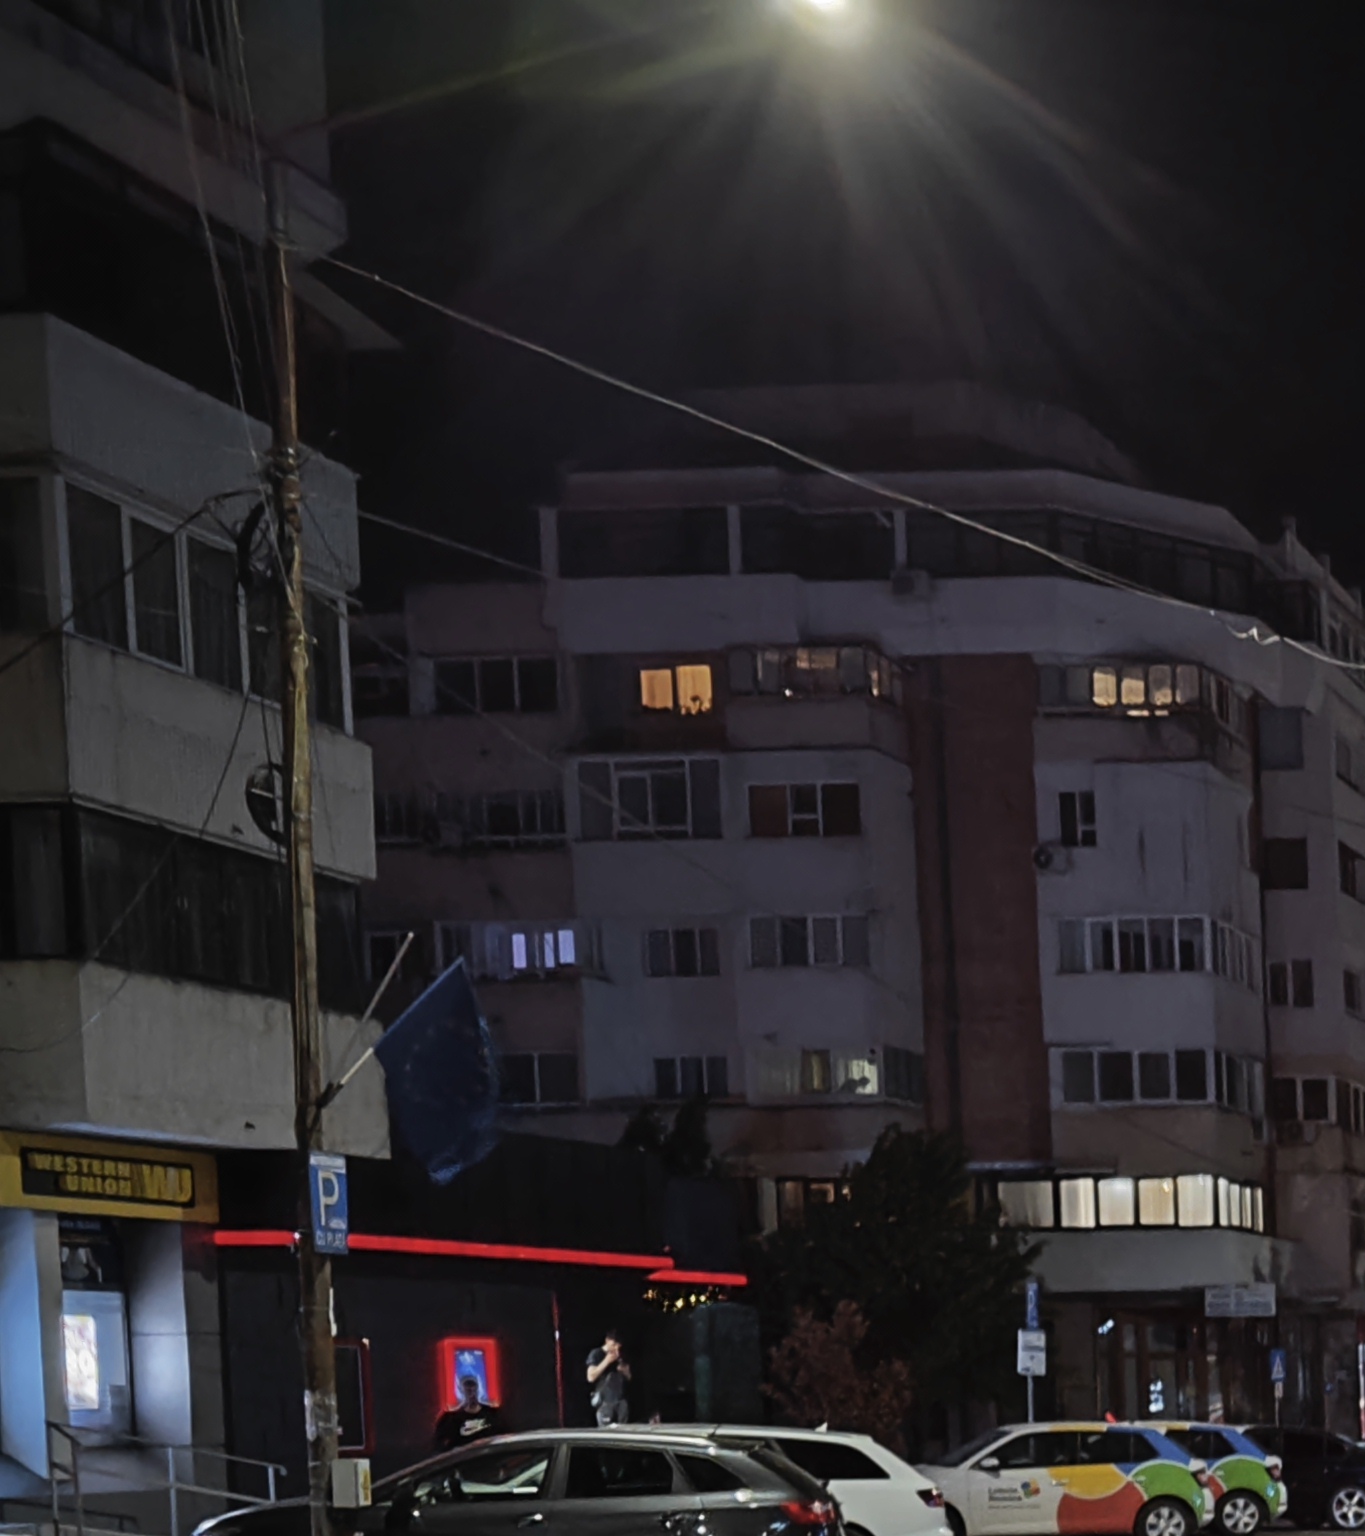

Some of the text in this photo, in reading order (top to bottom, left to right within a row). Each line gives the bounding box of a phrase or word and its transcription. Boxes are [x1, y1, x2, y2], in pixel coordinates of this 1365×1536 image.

[29, 1152, 132, 1178] WESTERN
[60, 1174, 132, 1197] UNION
[318, 1170, 339, 1226] P
